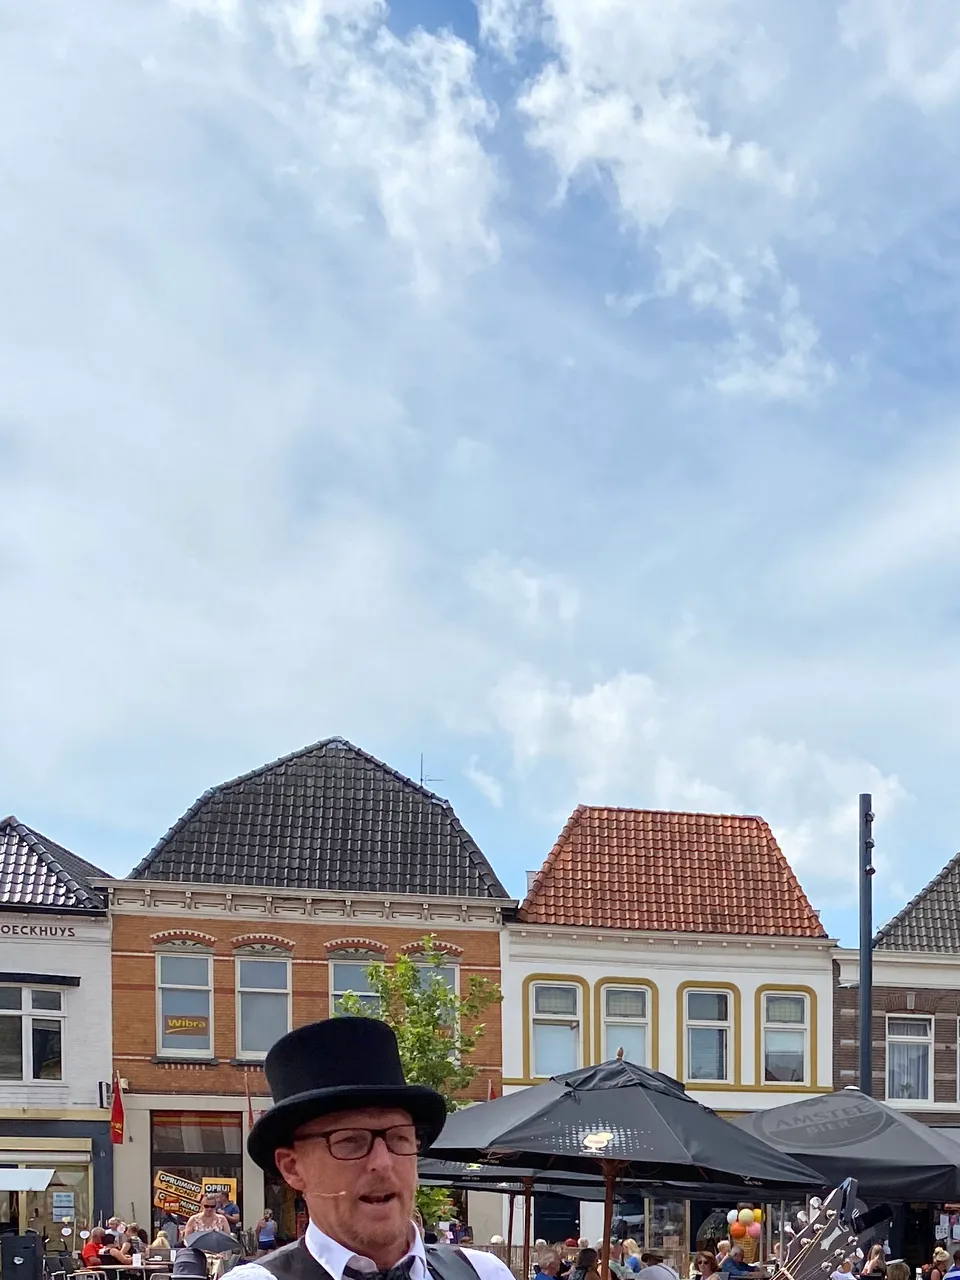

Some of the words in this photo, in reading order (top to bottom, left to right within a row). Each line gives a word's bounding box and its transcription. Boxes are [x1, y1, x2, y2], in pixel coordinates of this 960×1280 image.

[167, 1017, 206, 1028] Wibra
[776, 1102, 876, 1129] AMSTEL
[806, 1120, 852, 1135] BIER
[160, 1174, 201, 1192] OPRUIMING
